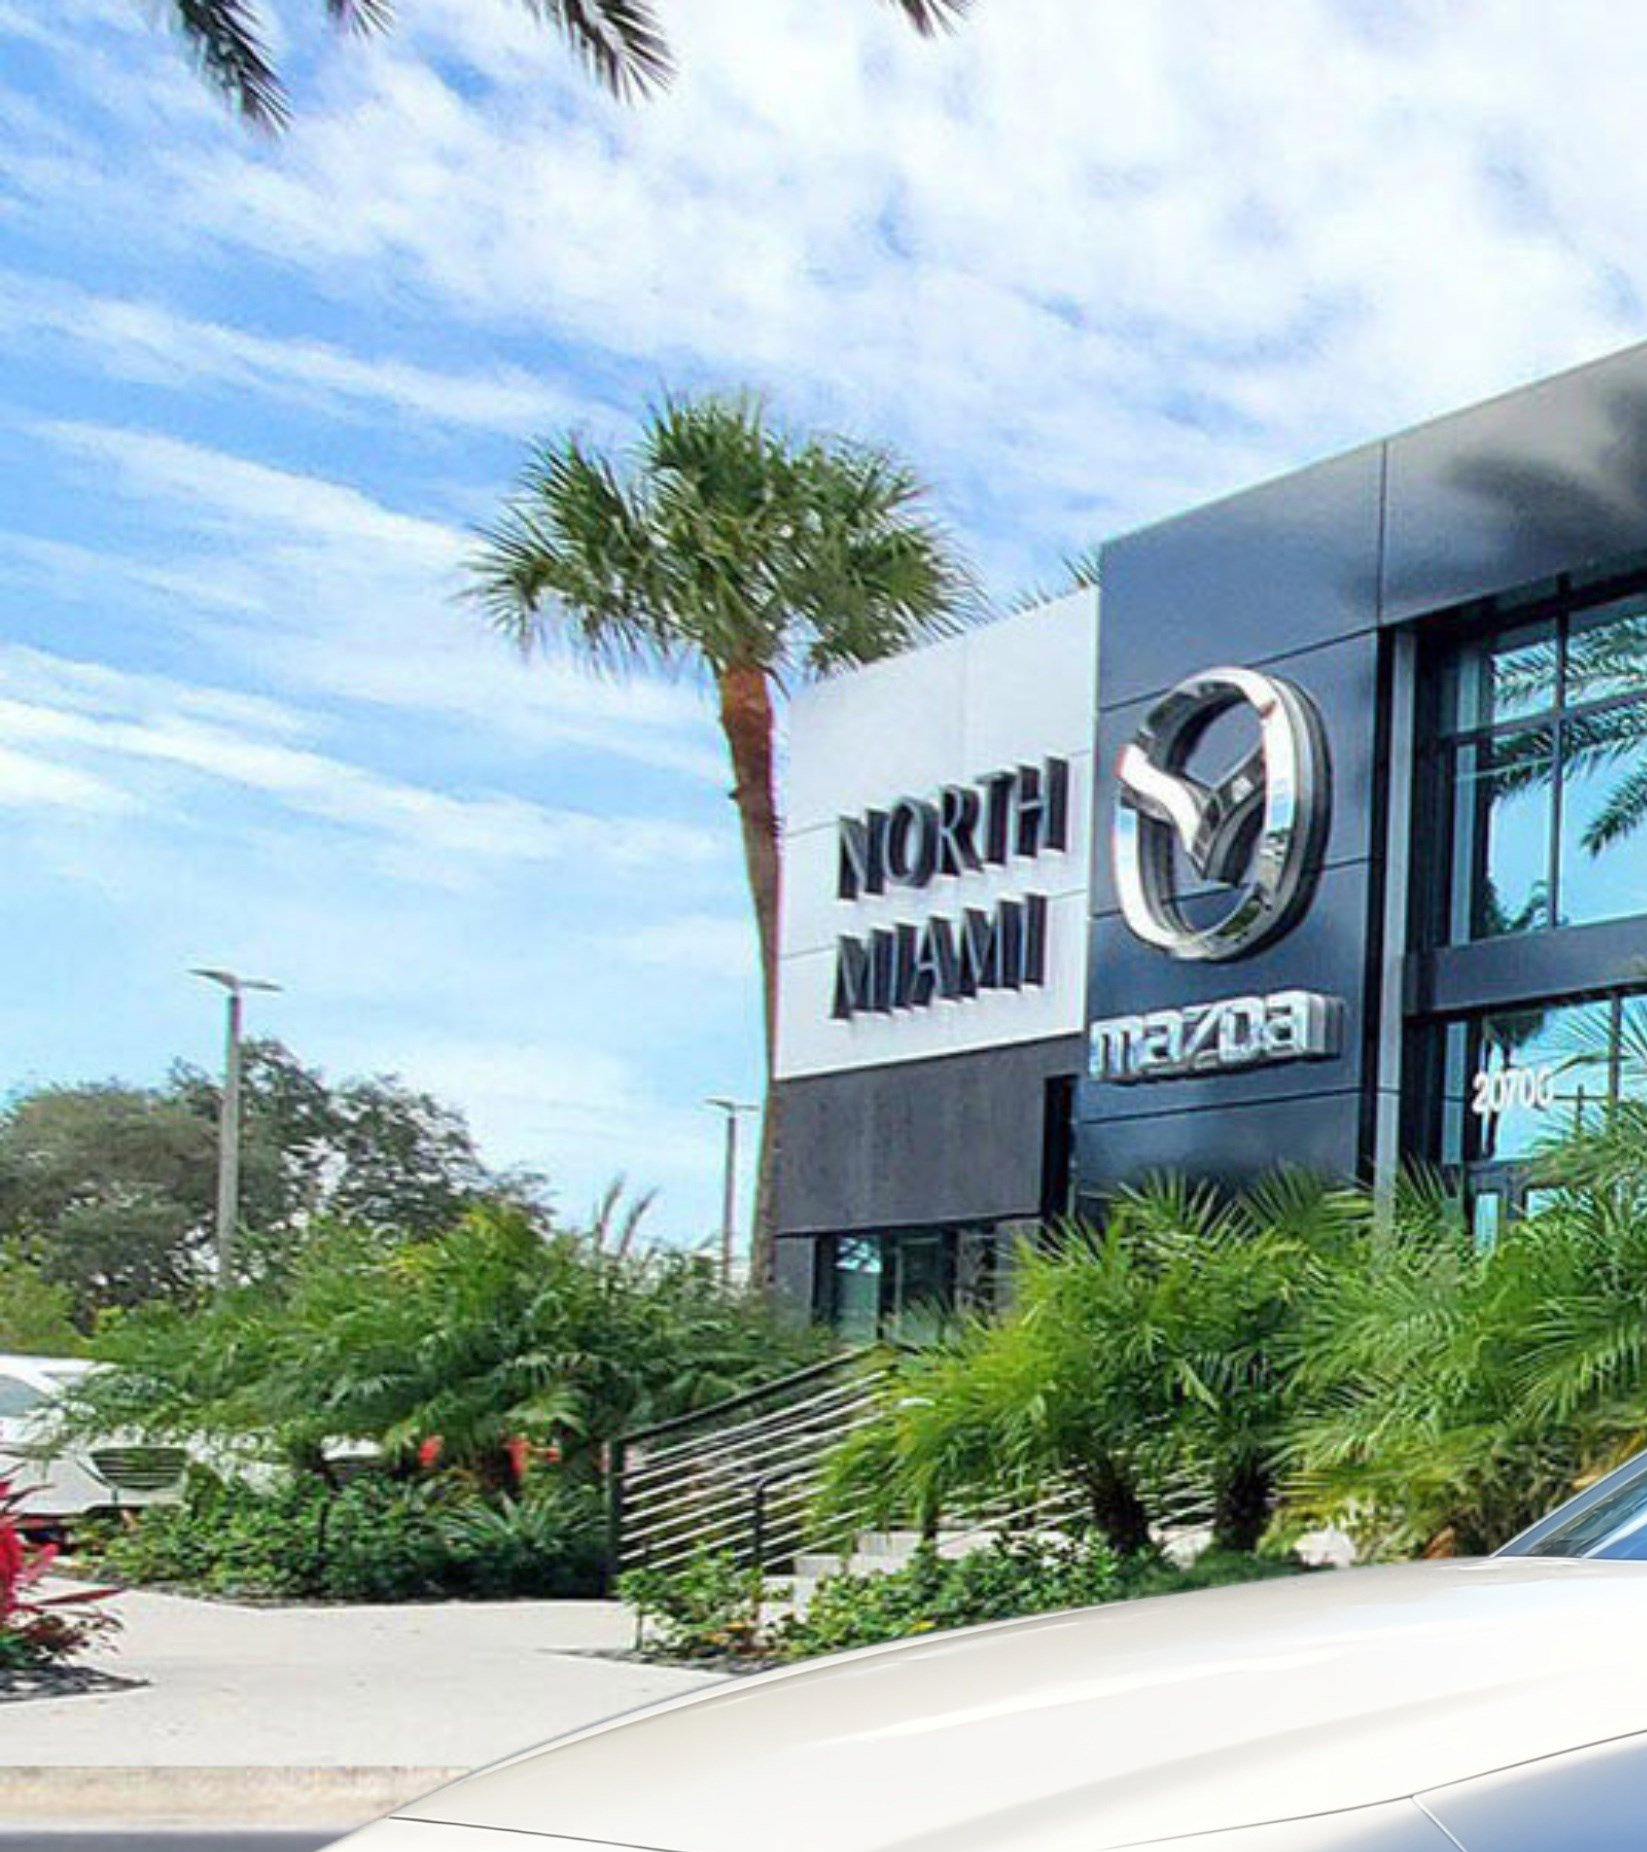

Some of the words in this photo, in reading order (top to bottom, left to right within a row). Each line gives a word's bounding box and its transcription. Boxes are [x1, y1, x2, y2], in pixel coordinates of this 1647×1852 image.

[838, 755, 1069, 901] NORTH
[831, 893, 1047, 1019] MIAMI
[1089, 989, 1334, 1081] mazda
